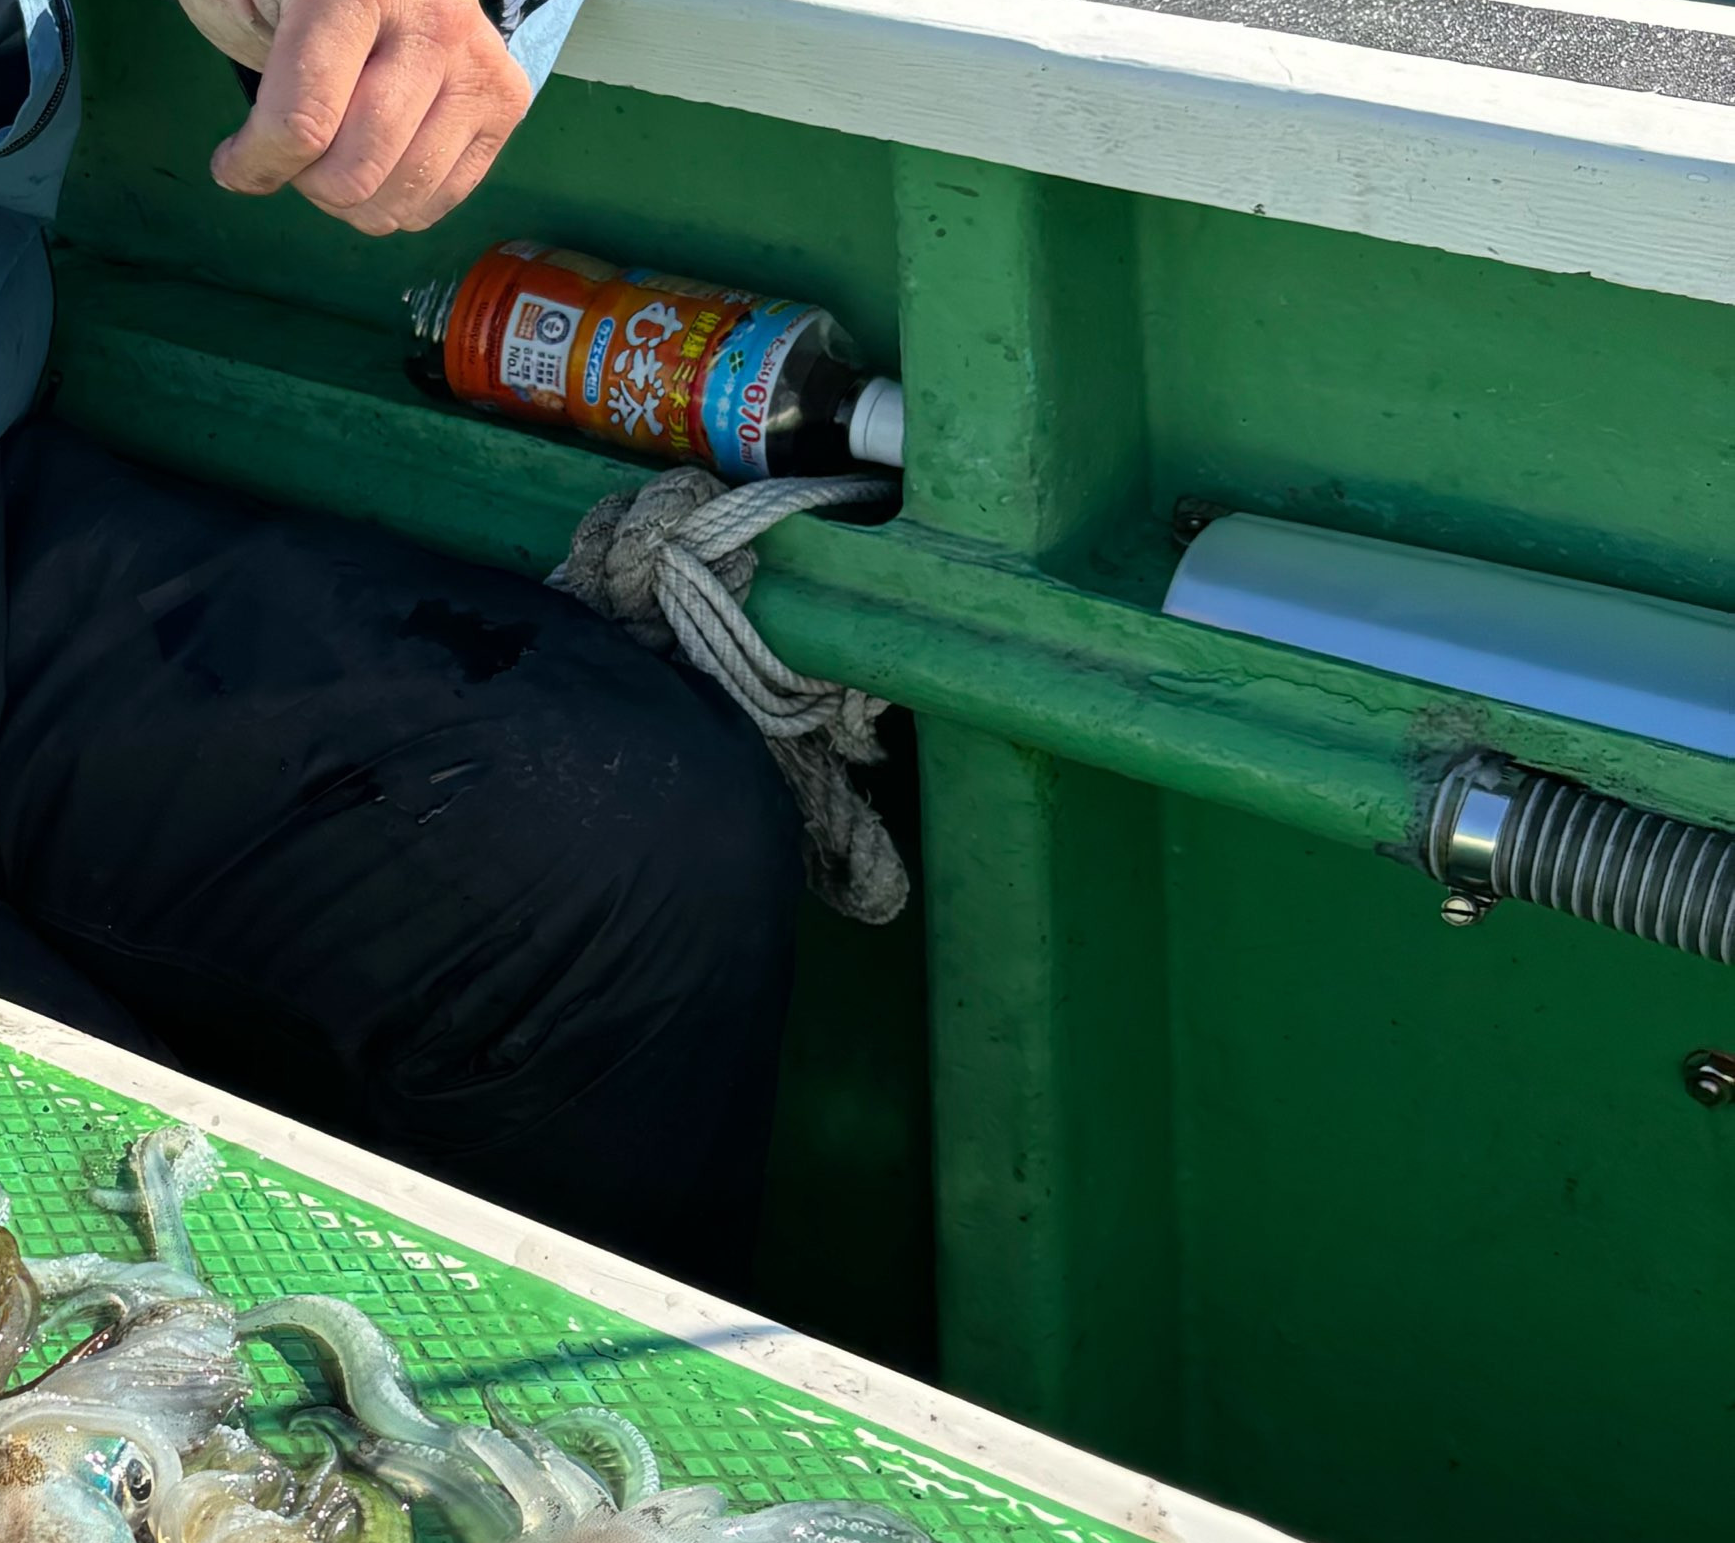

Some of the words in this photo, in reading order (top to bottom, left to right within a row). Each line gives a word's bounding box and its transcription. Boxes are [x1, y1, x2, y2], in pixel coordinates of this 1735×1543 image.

[507, 345, 521, 378] No.1
[607, 301, 683, 436] むぎ茶
[668, 311, 721, 450] 健康ミネラル
